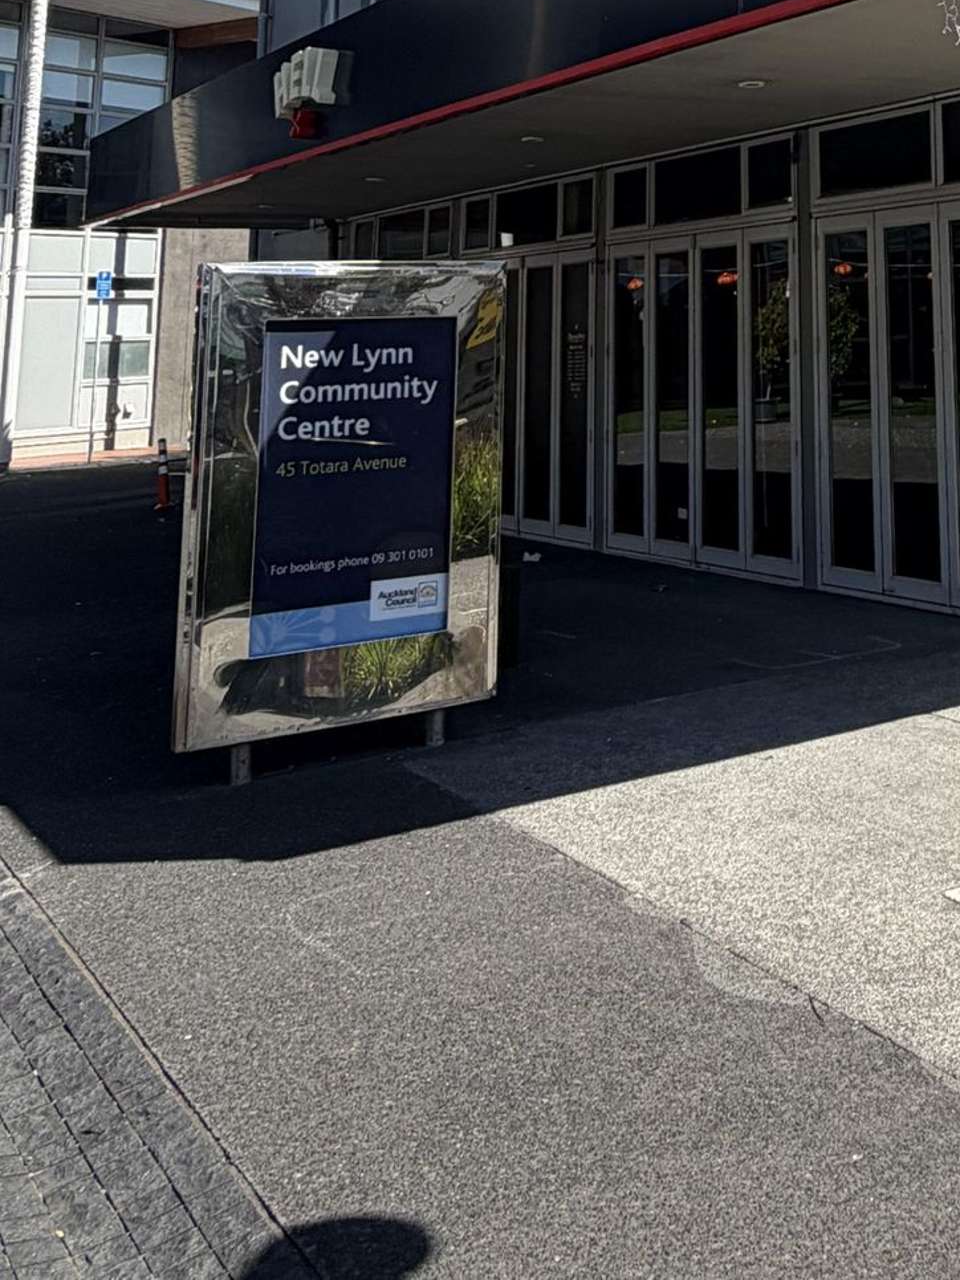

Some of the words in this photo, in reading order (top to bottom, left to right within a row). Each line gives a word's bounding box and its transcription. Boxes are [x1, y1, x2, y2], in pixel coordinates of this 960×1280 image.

[280, 344, 345, 369] New
[352, 343, 413, 373] Lynn
[279, 375, 439, 405] Community
[277, 416, 371, 441] Centre
[275, 461, 296, 478] 45
[301, 459, 349, 476] Totara
[353, 456, 407, 471] Avenue
[270, 564, 289, 576] For
[290, 559, 336, 573] bookings
[337, 557, 370, 571] phone
[371, 552, 385, 565] 09
[387, 549, 406, 562] 301
[408, 547, 434, 561] 0101
[377, 586, 418, 600] Auckland
[384, 596, 417, 608] Council
